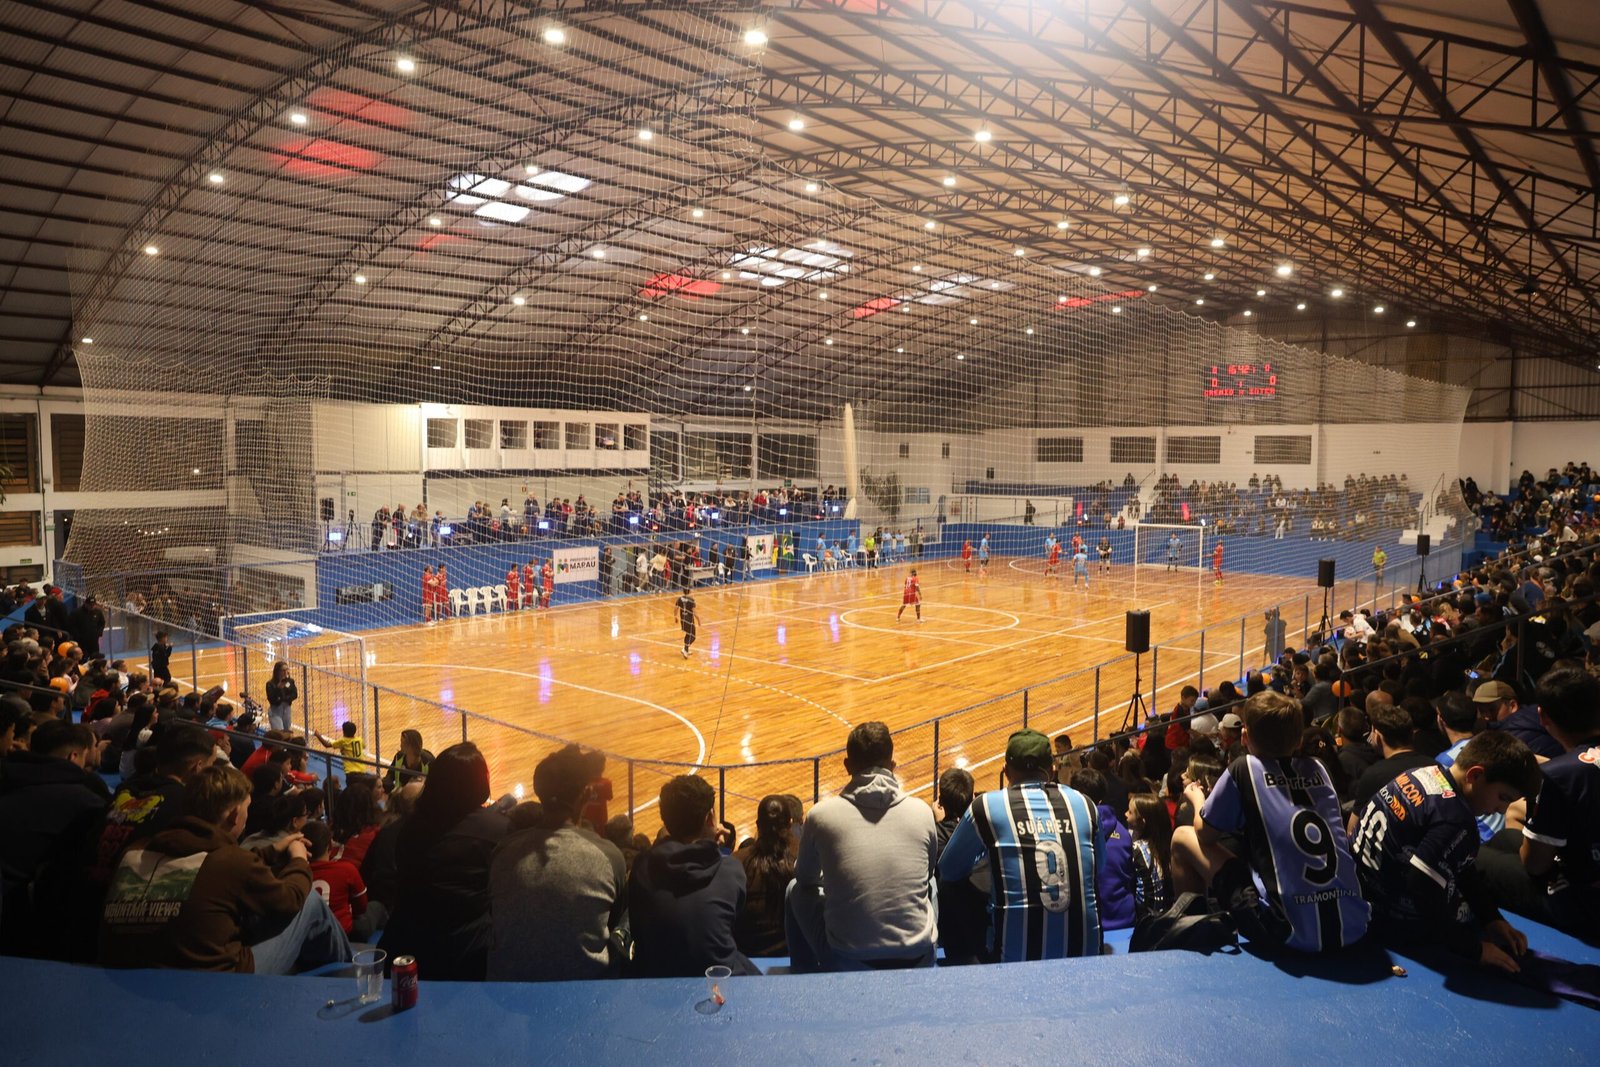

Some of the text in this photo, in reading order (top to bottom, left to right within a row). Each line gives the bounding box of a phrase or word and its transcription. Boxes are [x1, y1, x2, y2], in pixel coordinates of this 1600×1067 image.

[570, 561, 596, 569] MARAU
[351, 741, 361, 758] 10
[1017, 817, 1072, 835] SUÁREZ
[1290, 808, 1339, 887] 9
[1035, 840, 1071, 913] 9
[149, 901, 182, 917] VIEWS
